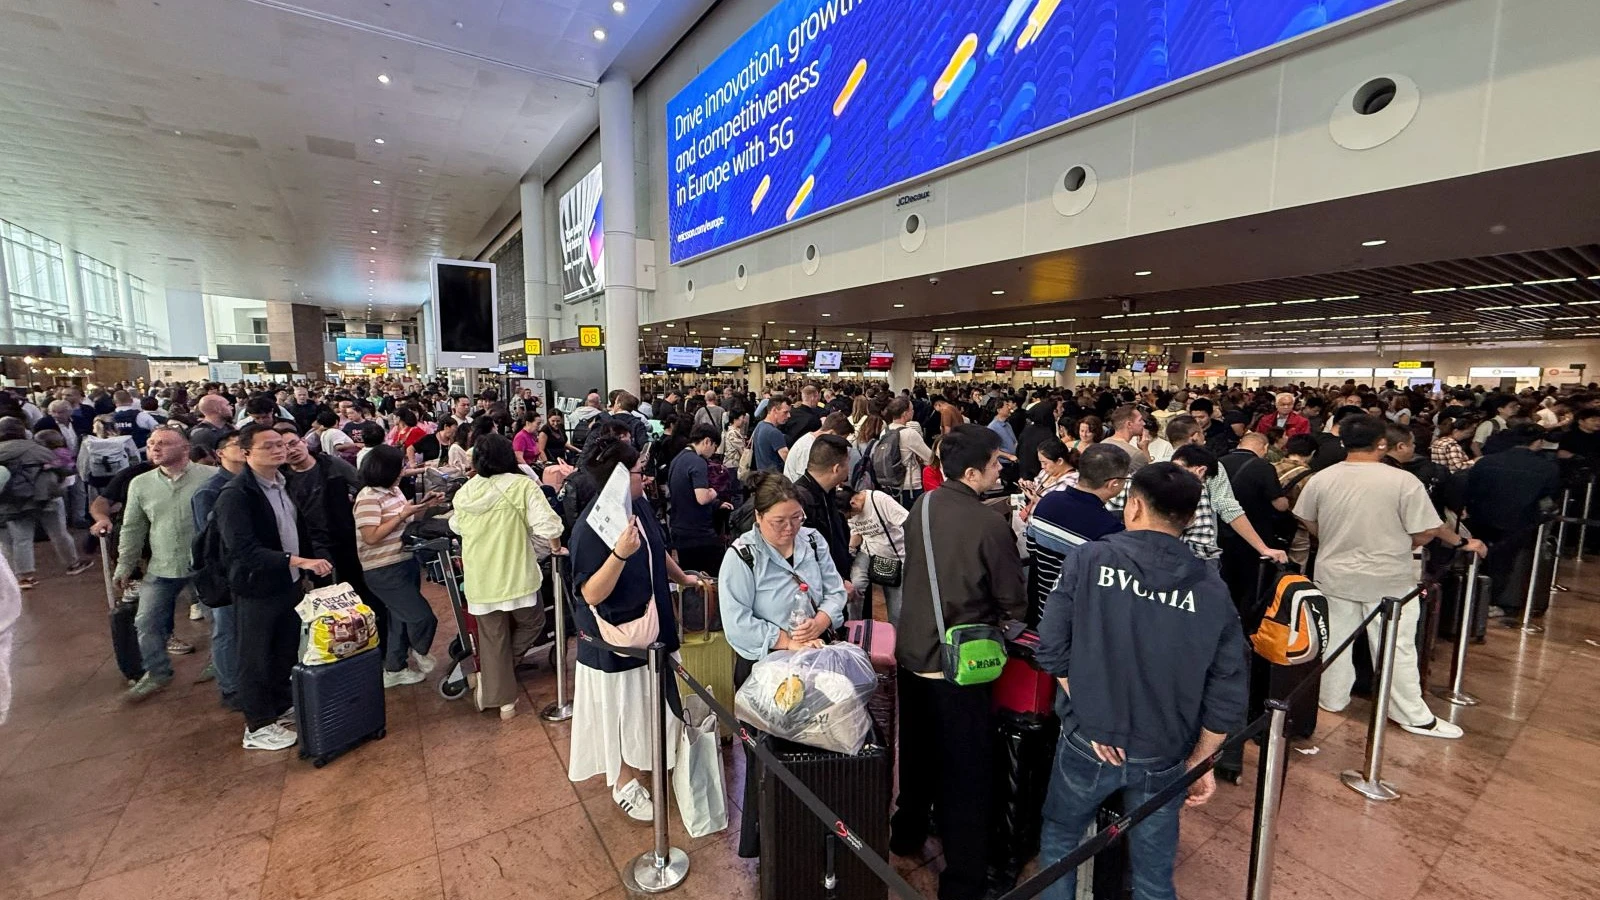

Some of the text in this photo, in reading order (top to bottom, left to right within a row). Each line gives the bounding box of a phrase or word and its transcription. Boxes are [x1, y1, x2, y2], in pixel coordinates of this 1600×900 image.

[675, 0, 863, 141] Drive innovation, growt
[675, 60, 820, 173] and competitiveness
[676, 116, 794, 207] in Europe with 5G
[677, 216, 725, 243] ericsson.com/europe
[527, 344, 538, 352] 07
[583, 333, 597, 344] 08
